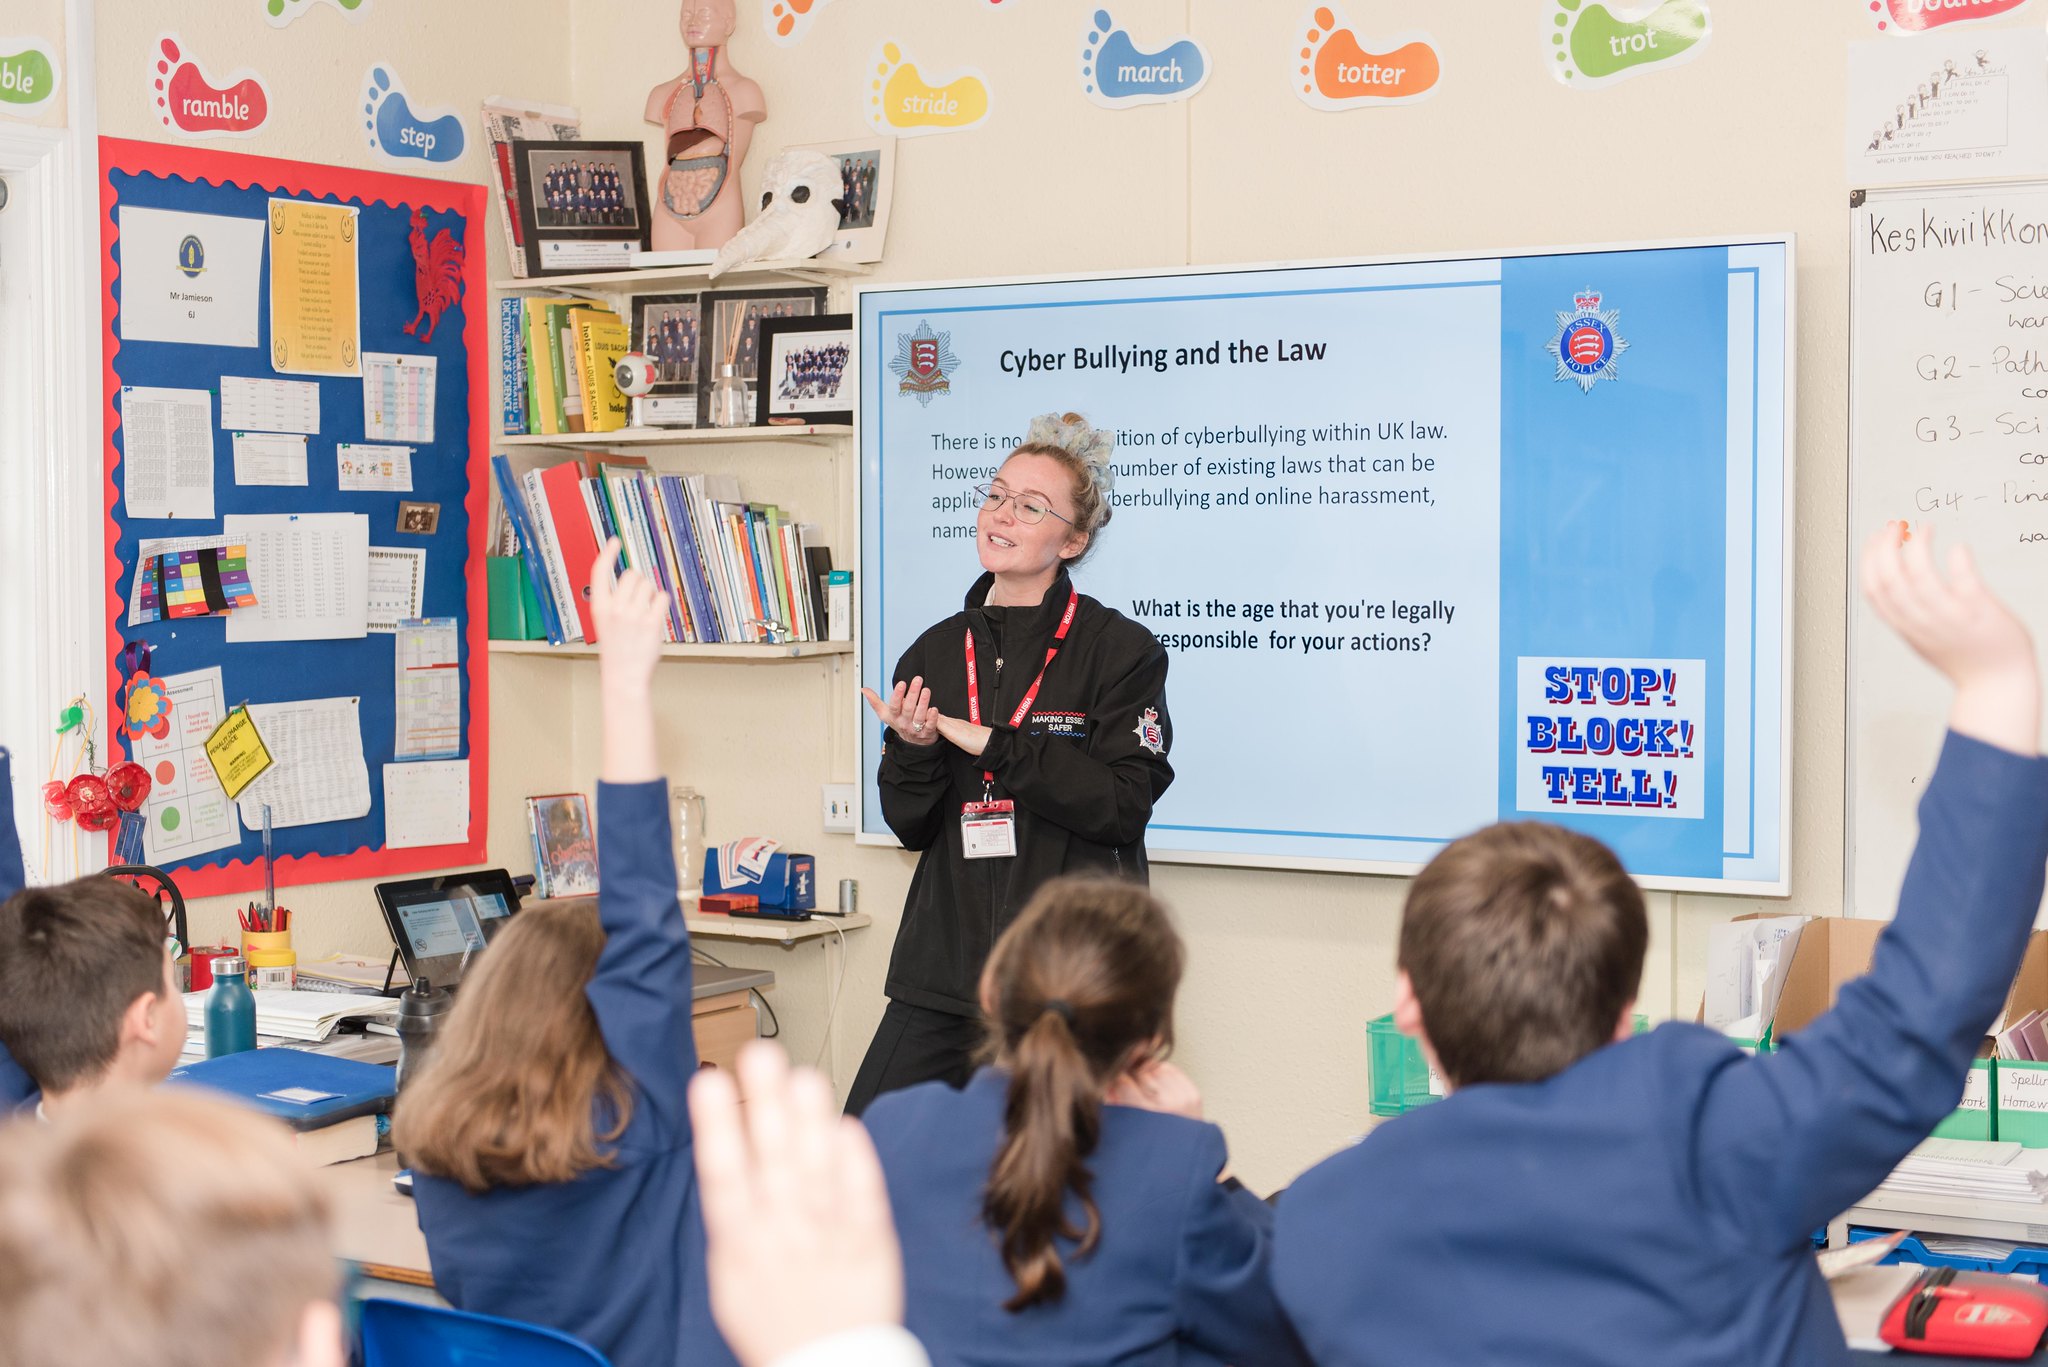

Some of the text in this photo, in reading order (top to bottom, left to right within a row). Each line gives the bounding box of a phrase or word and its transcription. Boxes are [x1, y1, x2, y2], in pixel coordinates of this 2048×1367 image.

[1609, 28, 1658, 57] trot
[1117, 59, 1184, 84] march
[1337, 61, 1406, 85] totter
[183, 94, 249, 121] ramble
[902, 93, 959, 116] stride
[400, 127, 436, 157] step
[170, 291, 213, 303] Mr Jamieson
[511, 299, 520, 315] THE
[188, 310, 196, 319] 6J
[1568, 319, 1606, 334] ESSEX
[582, 325, 592, 352] holes
[611, 342, 628, 351] SACHA
[502, 299, 513, 412] DICTIONARY OF SCIENCE
[1000, 338, 1327, 377] Cyber Bullying and the Law
[1565, 356, 1609, 374] POLICE
[1916, 354, 1963, 381] G2
[586, 365, 599, 421] LOUIS SACHAR
[931, 433, 979, 451] There
[984, 433, 996, 449] is
[1161, 426, 1180, 446] of
[1184, 424, 1306, 448] cyberbullying
[1313, 422, 1371, 442] within
[1378, 422, 1404, 441] UK
[1410, 420, 1448, 439] law.
[1915, 415, 1961, 443] G3
[932, 452, 1436, 480] Howeve number of existing laws that can be
[1215, 486, 1249, 507] and
[1255, 486, 1312, 506] online
[1318, 485, 1436, 507] harassment,
[1915, 486, 1964, 513] G4
[527, 475, 572, 637] Life in Colchester during World War Two
[1063, 601, 1076, 625] VISITOR
[1132, 598, 1456, 625] What is the age that you're legally
[1153, 630, 1432, 654] responsible for your actions?
[1545, 666, 1677, 707] STOP!
[970, 695, 978, 721] VISITOR
[1013, 697, 1033, 723] VISITOR
[1032, 716, 1064, 724] MAKING
[228, 718, 247, 738] CHARGE
[1048, 723, 1073, 732] SAFER
[1527, 715, 1694, 758] BLOCK!
[222, 734, 239, 752] NOTICE
[1542, 765, 1678, 809] TELL!
